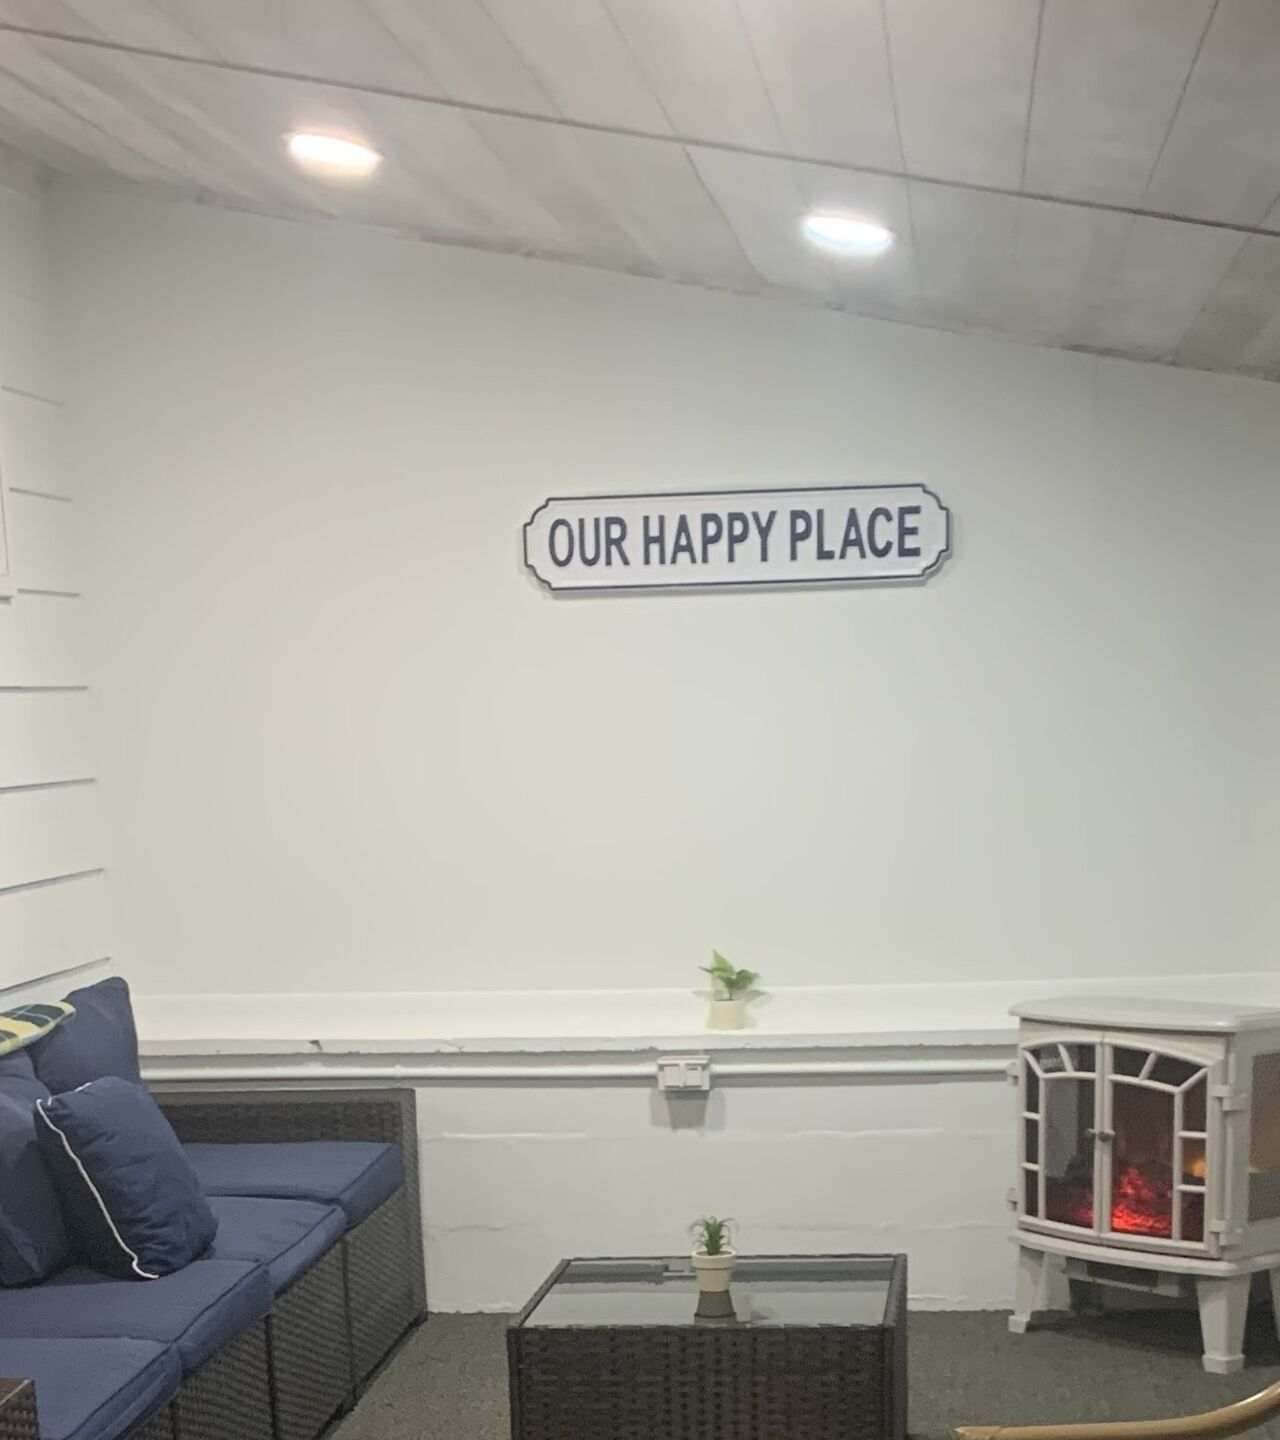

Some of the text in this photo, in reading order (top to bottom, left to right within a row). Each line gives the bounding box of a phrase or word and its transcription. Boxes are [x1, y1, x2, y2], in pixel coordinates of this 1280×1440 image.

[548, 505, 922, 567] OUR HAPPY PLACE
